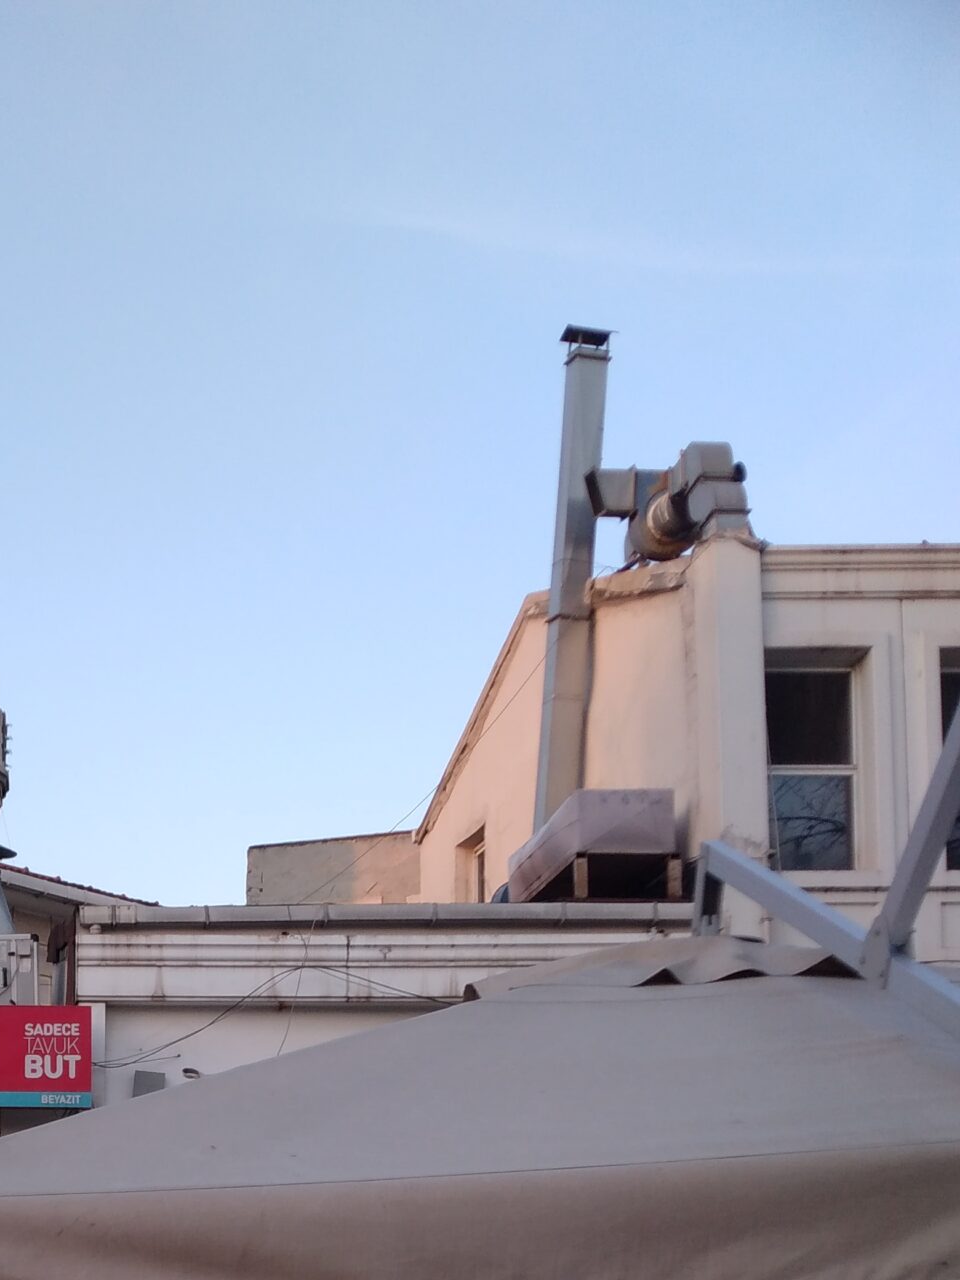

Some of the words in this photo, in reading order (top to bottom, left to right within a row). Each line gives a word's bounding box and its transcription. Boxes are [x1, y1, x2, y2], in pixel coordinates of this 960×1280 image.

[24, 1023, 80, 1036] SADECE
[24, 1036, 80, 1054] TAVUK
[24, 1054, 81, 1079] BUT
